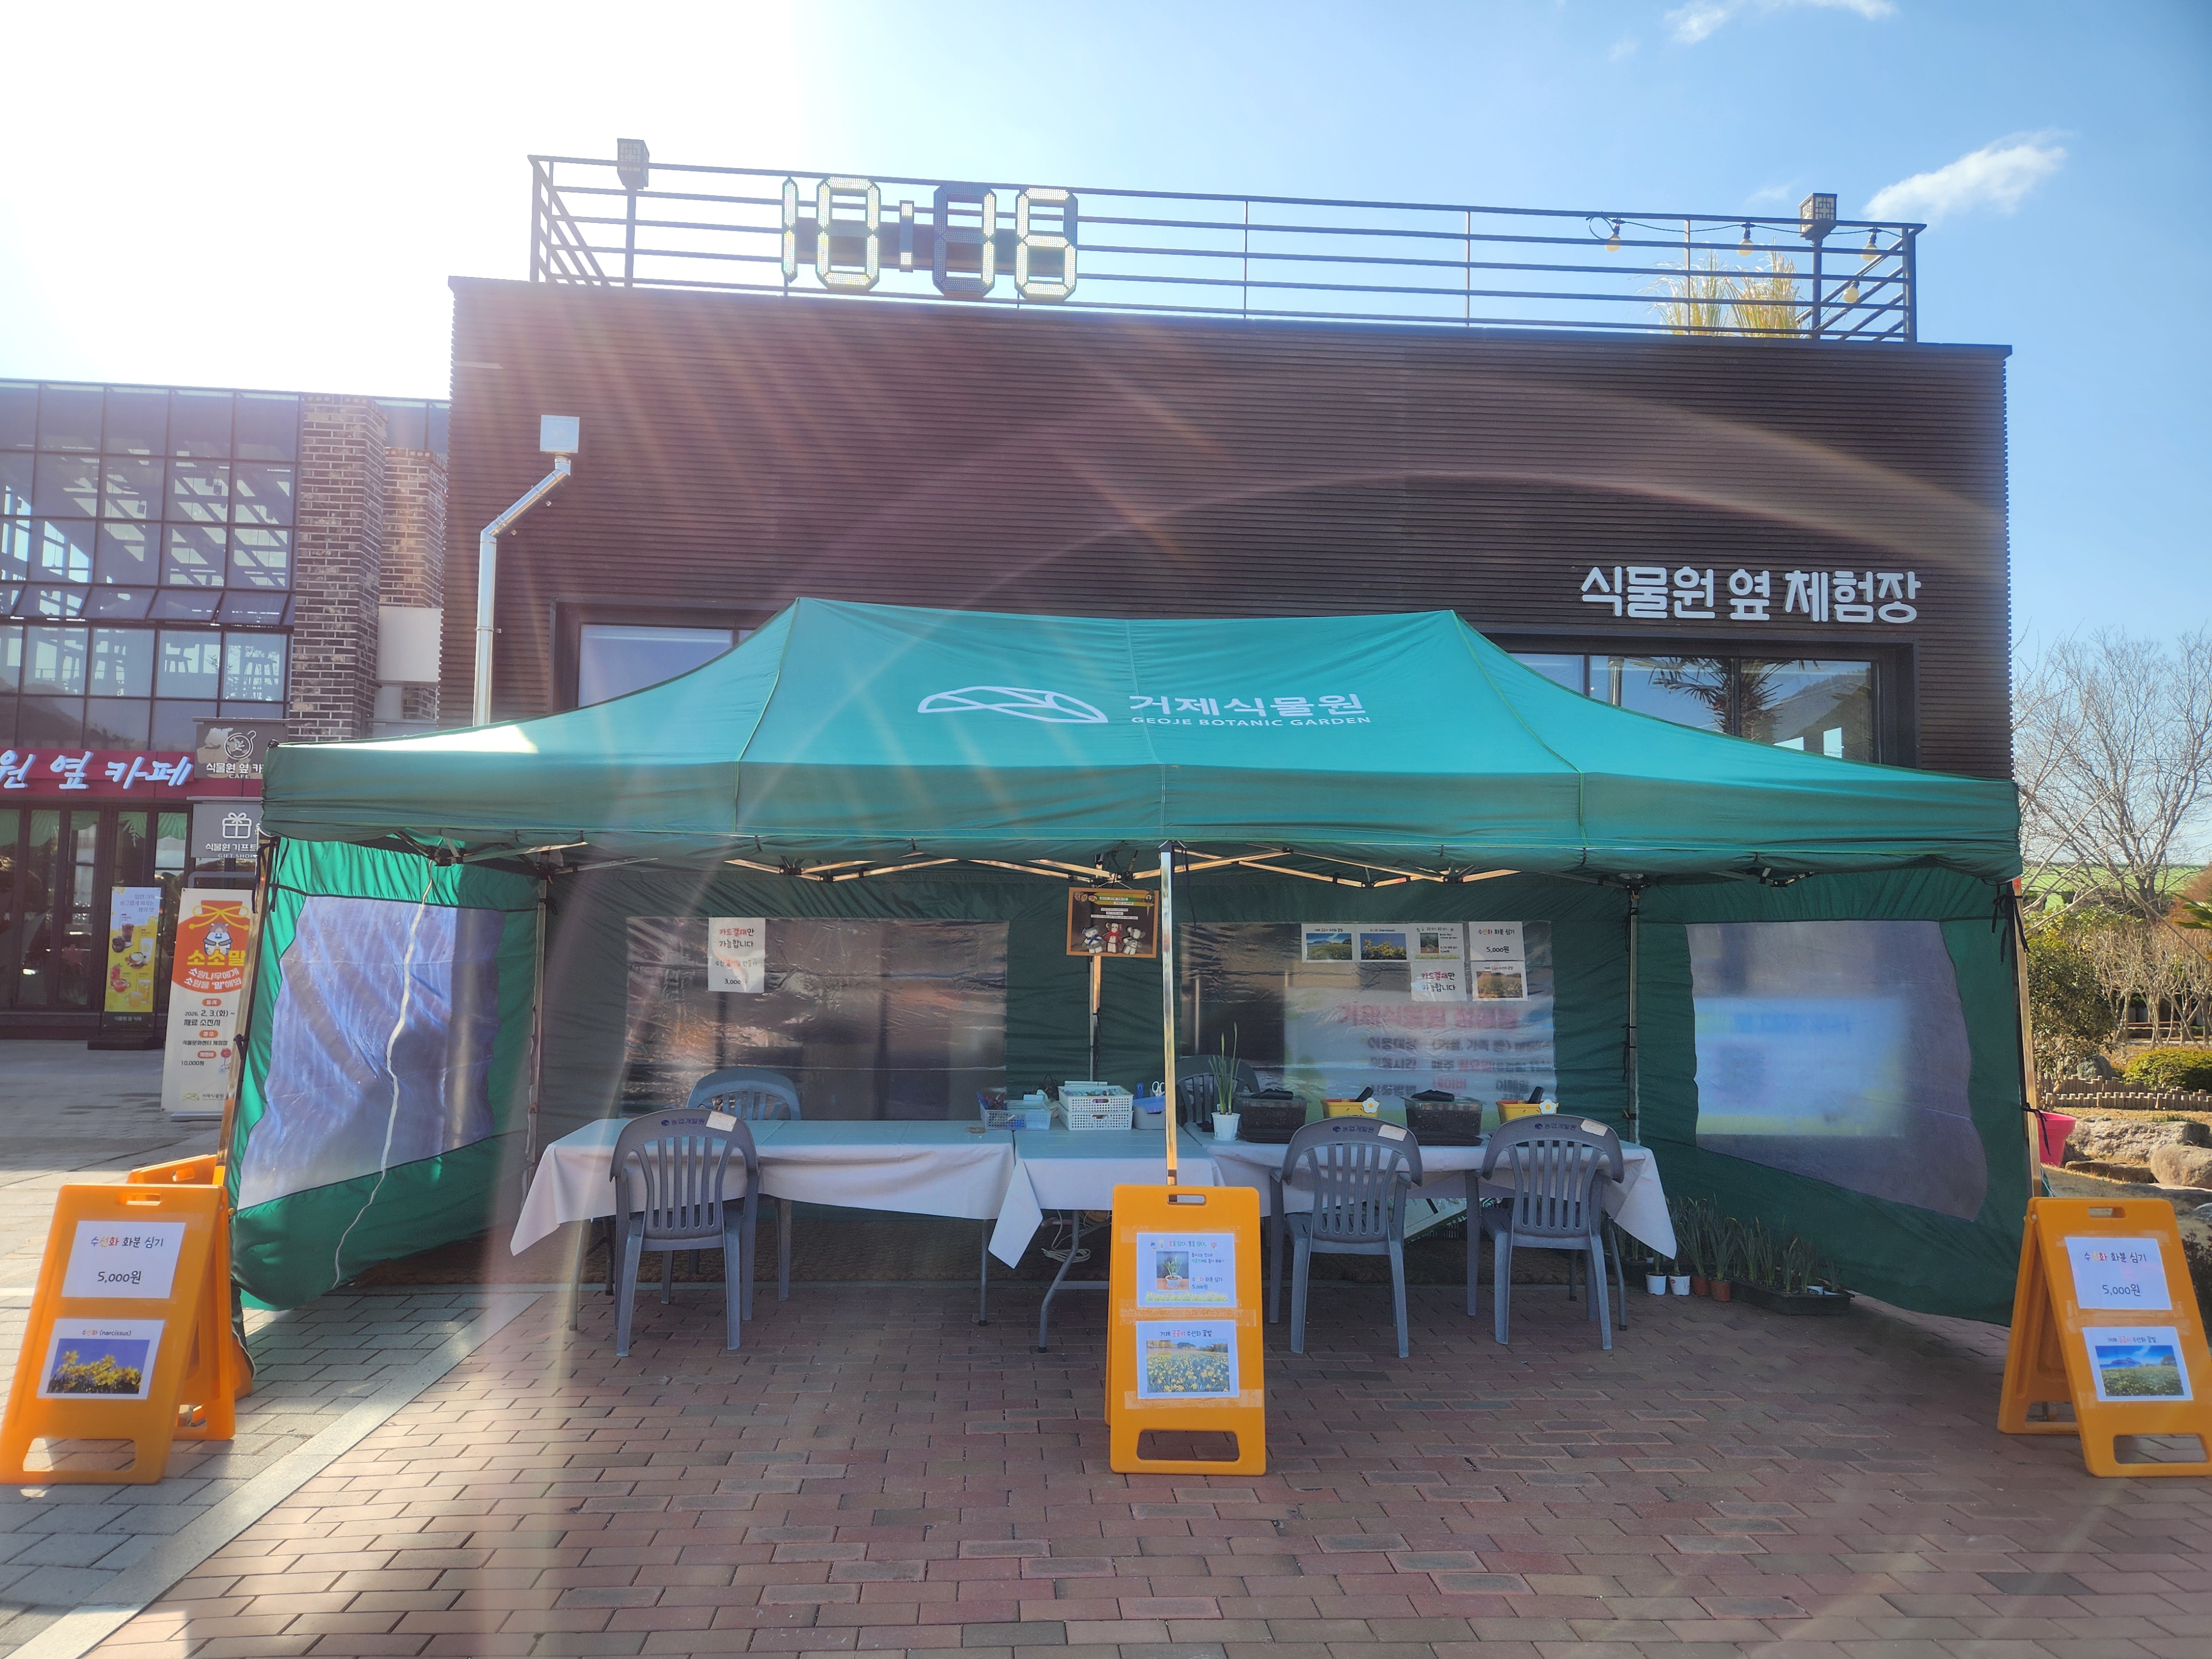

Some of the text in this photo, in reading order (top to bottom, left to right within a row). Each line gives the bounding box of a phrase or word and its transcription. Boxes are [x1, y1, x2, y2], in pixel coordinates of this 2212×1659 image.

[1580, 566, 1921, 623] 식물원 옆 체험장
[1129, 693, 1366, 717] 거제식물원
[1131, 717, 1192, 725] GEOJE
[1290, 716, 1371, 726] GARDEN
[50, 751, 94, 790] 옆
[105, 756, 194, 790] 카페
[206, 763, 264, 774] 식물원 옆 카
[206, 843, 230, 852] 식물원
[719, 939, 754, 948] 가능합니다
[91, 1237, 164, 1249] 수선화 화분 심기
[2084, 1252, 2147, 1263] 수선화 화분 심기
[97, 1271, 142, 1284] 5,000원
[2102, 1284, 2141, 1296] 5,000원
